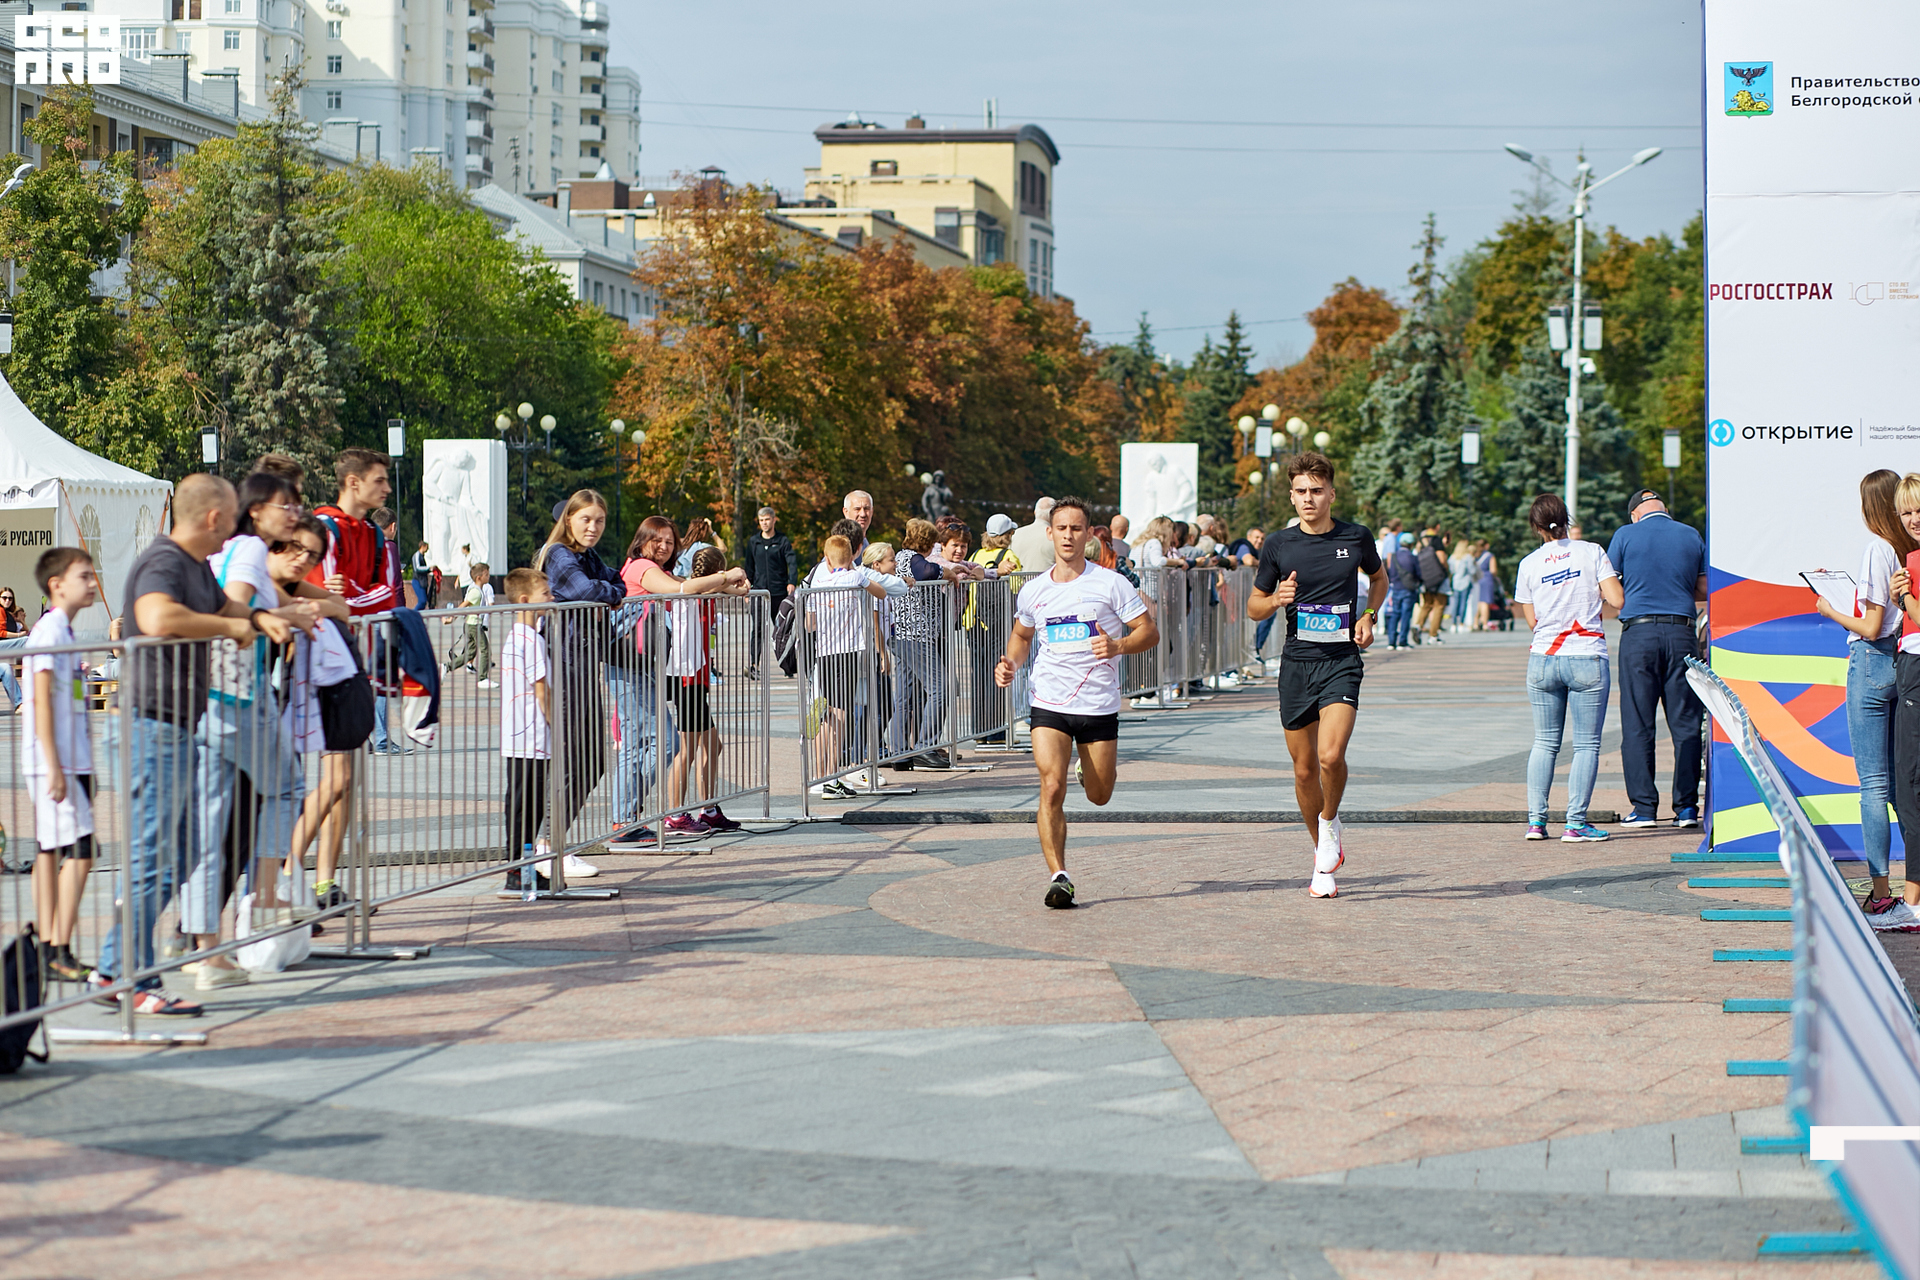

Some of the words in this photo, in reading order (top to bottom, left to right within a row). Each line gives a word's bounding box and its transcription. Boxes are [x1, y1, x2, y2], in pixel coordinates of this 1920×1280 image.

[1791, 76, 1920, 90] Правительство
[1791, 92, 1912, 109] Белгородской
[1710, 283, 1833, 300] РОСГОССТРАХ
[1742, 425, 1853, 444] открытие
[10, 530, 52, 546] РУСАГРО
[1304, 616, 1336, 630] 1026
[1054, 625, 1086, 641] 1438
